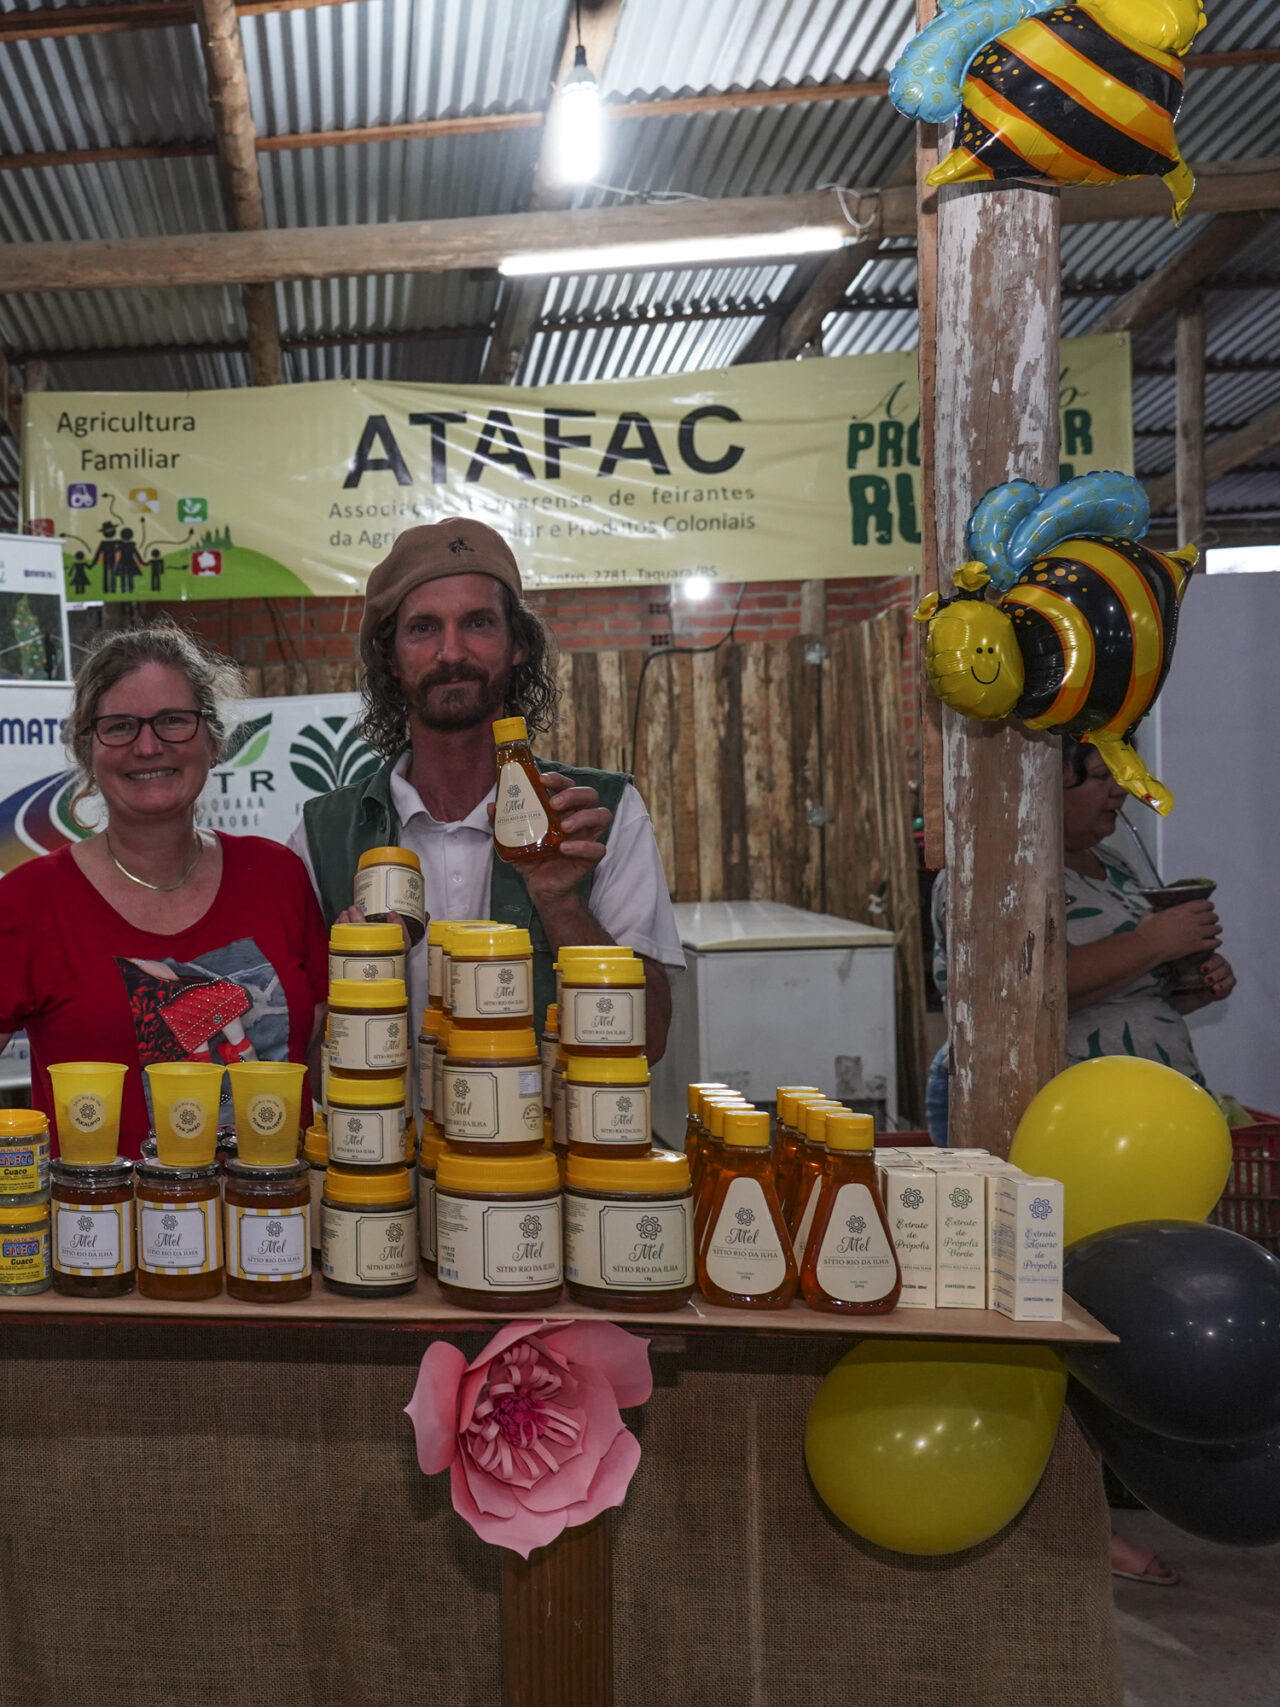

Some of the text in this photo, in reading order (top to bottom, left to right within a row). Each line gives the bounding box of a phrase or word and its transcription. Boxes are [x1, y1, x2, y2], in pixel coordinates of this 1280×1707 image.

[56, 411, 196, 438] Agricultura
[342, 405, 745, 490] ATAFAC
[81, 448, 181, 471] Familiar
[609, 488, 635, 506] de
[652, 486, 756, 505] feirantes
[329, 529, 352, 547] da
[549, 524, 560, 538] e
[568, 518, 657, 537] Produtos
[663, 512, 756, 534] Coloniais
[591, 1015, 616, 1028] Mel
[450, 1101, 473, 1117] Mel
[896, 1218, 929, 1230] Extrato
[944, 1217, 978, 1228] Extrato
[70, 1233, 98, 1248] Mel
[155, 1233, 182, 1248] Mel
[724, 1228, 760, 1245] Mel
[907, 1231, 917, 1239] de
[955, 1229, 967, 1237] de
[1024, 1228, 1057, 1238] Extrato
[257, 1239, 287, 1255] Mel
[836, 1236, 871, 1254] Mel
[895, 1239, 930, 1252] Própolis
[943, 1237, 979, 1250] Própolis
[380, 1245, 405, 1261] Mel
[512, 1242, 545, 1262] Mel
[628, 1243, 664, 1262] Mel
[713, 1248, 732, 1256] SÍTIO
[946, 1249, 974, 1258] Verde
[1035, 1250, 1045, 1259] de
[612, 1264, 679, 1273] SÍTIO RIO DA ILHA
[1023, 1260, 1057, 1272] Própolis
